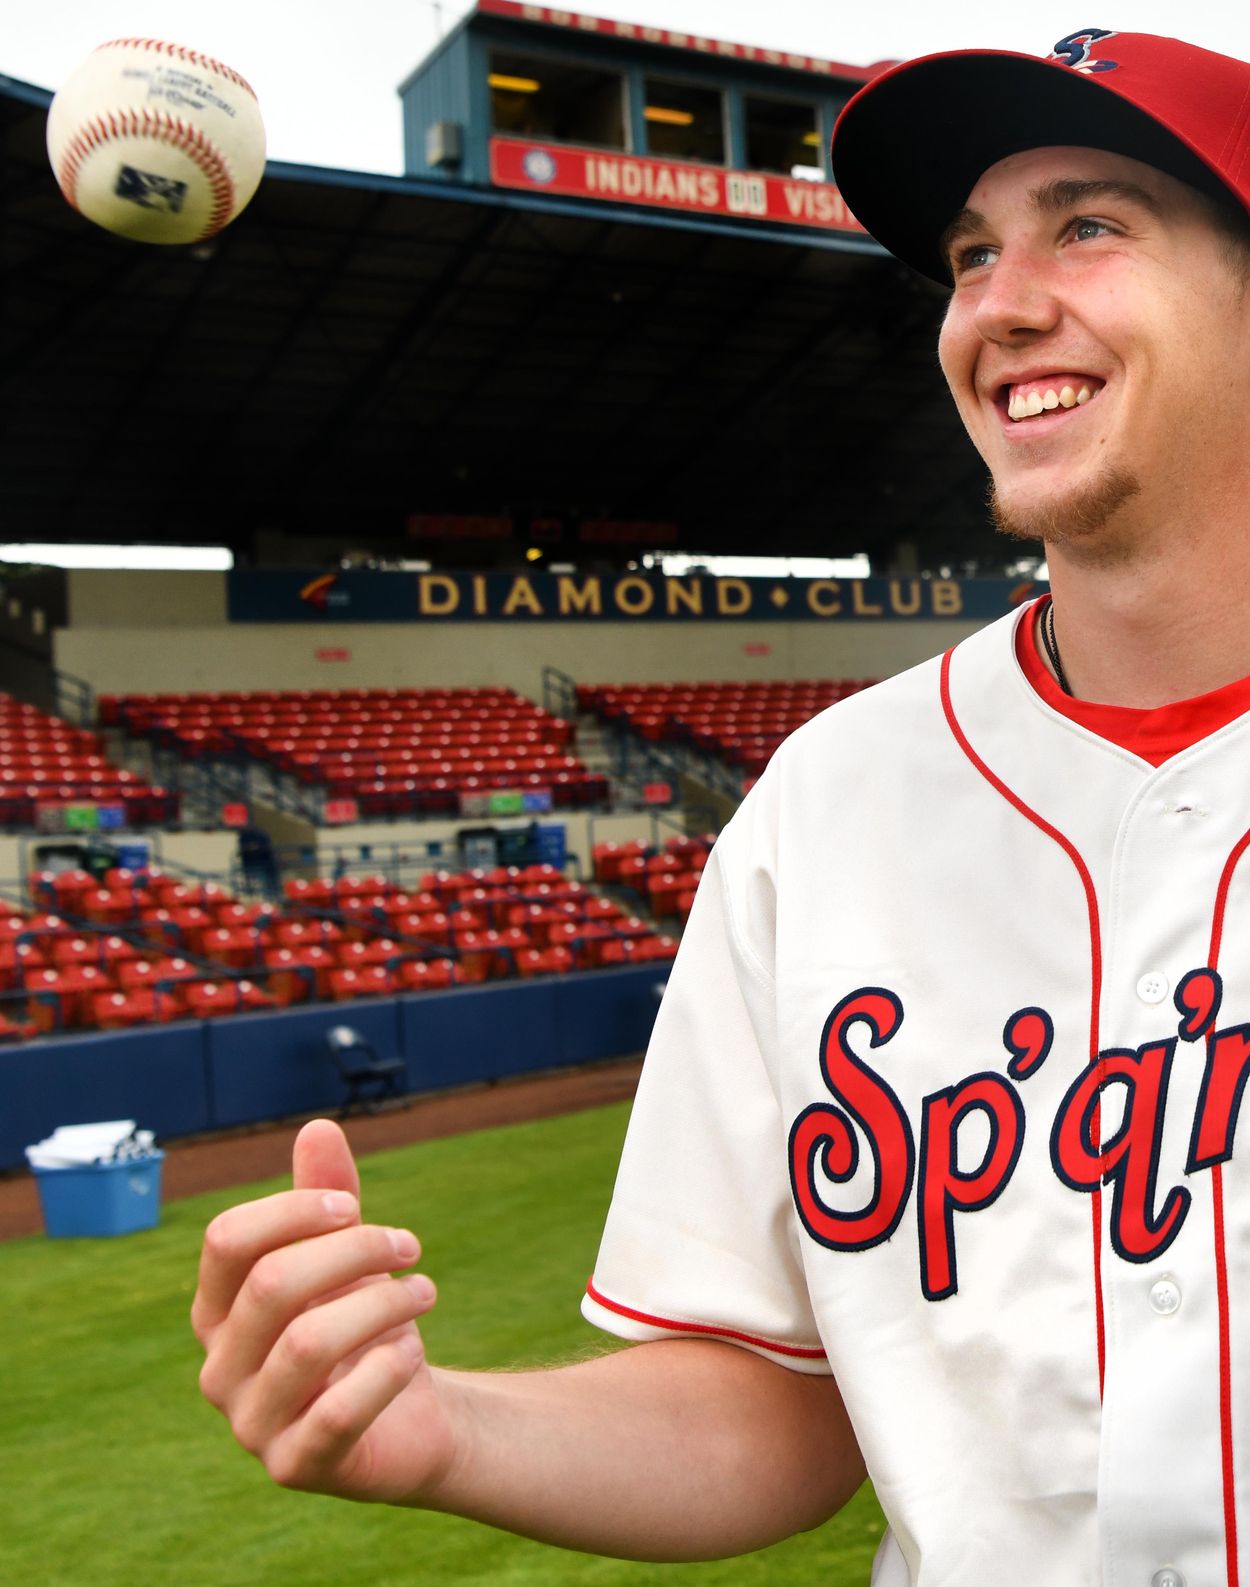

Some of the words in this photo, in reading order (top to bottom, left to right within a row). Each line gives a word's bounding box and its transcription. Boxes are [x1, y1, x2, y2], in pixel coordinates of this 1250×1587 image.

[585, 157, 720, 209] INDIANS
[785, 185, 858, 225] VISI
[418, 575, 754, 616] DIAMOND
[806, 578, 964, 616] CLUB
